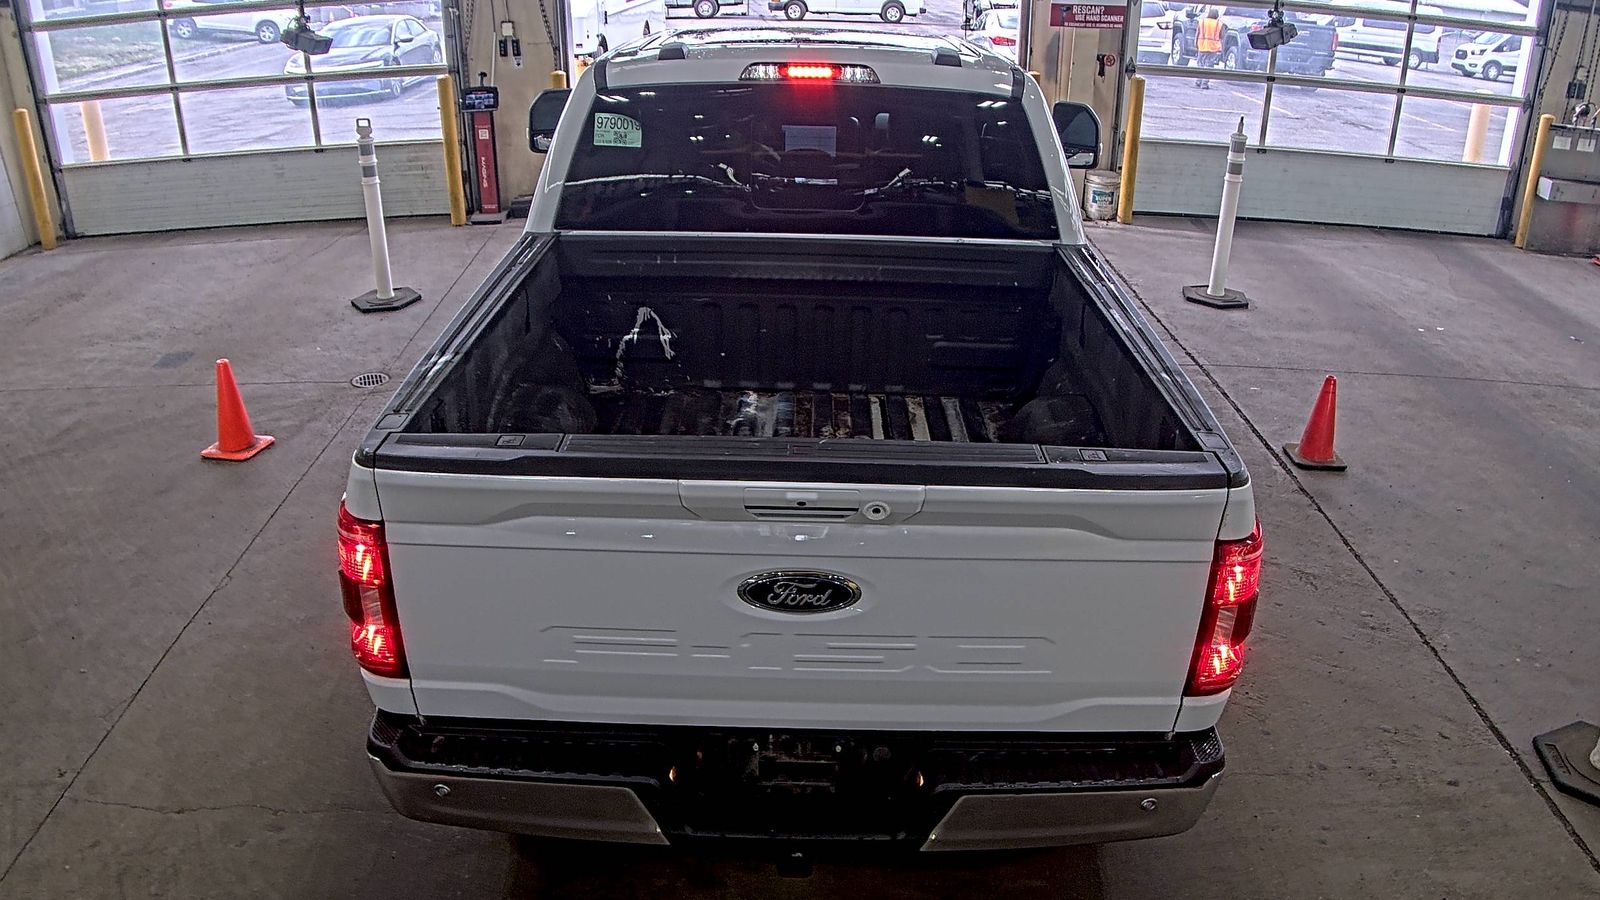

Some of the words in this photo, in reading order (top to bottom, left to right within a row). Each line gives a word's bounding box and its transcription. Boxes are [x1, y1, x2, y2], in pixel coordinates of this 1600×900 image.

[1072, 5, 1105, 15] RESCAN?
[1086, 14, 1101, 22] HAND
[596, 116, 641, 131] 9790019
[767, 581, 833, 606] Ford
